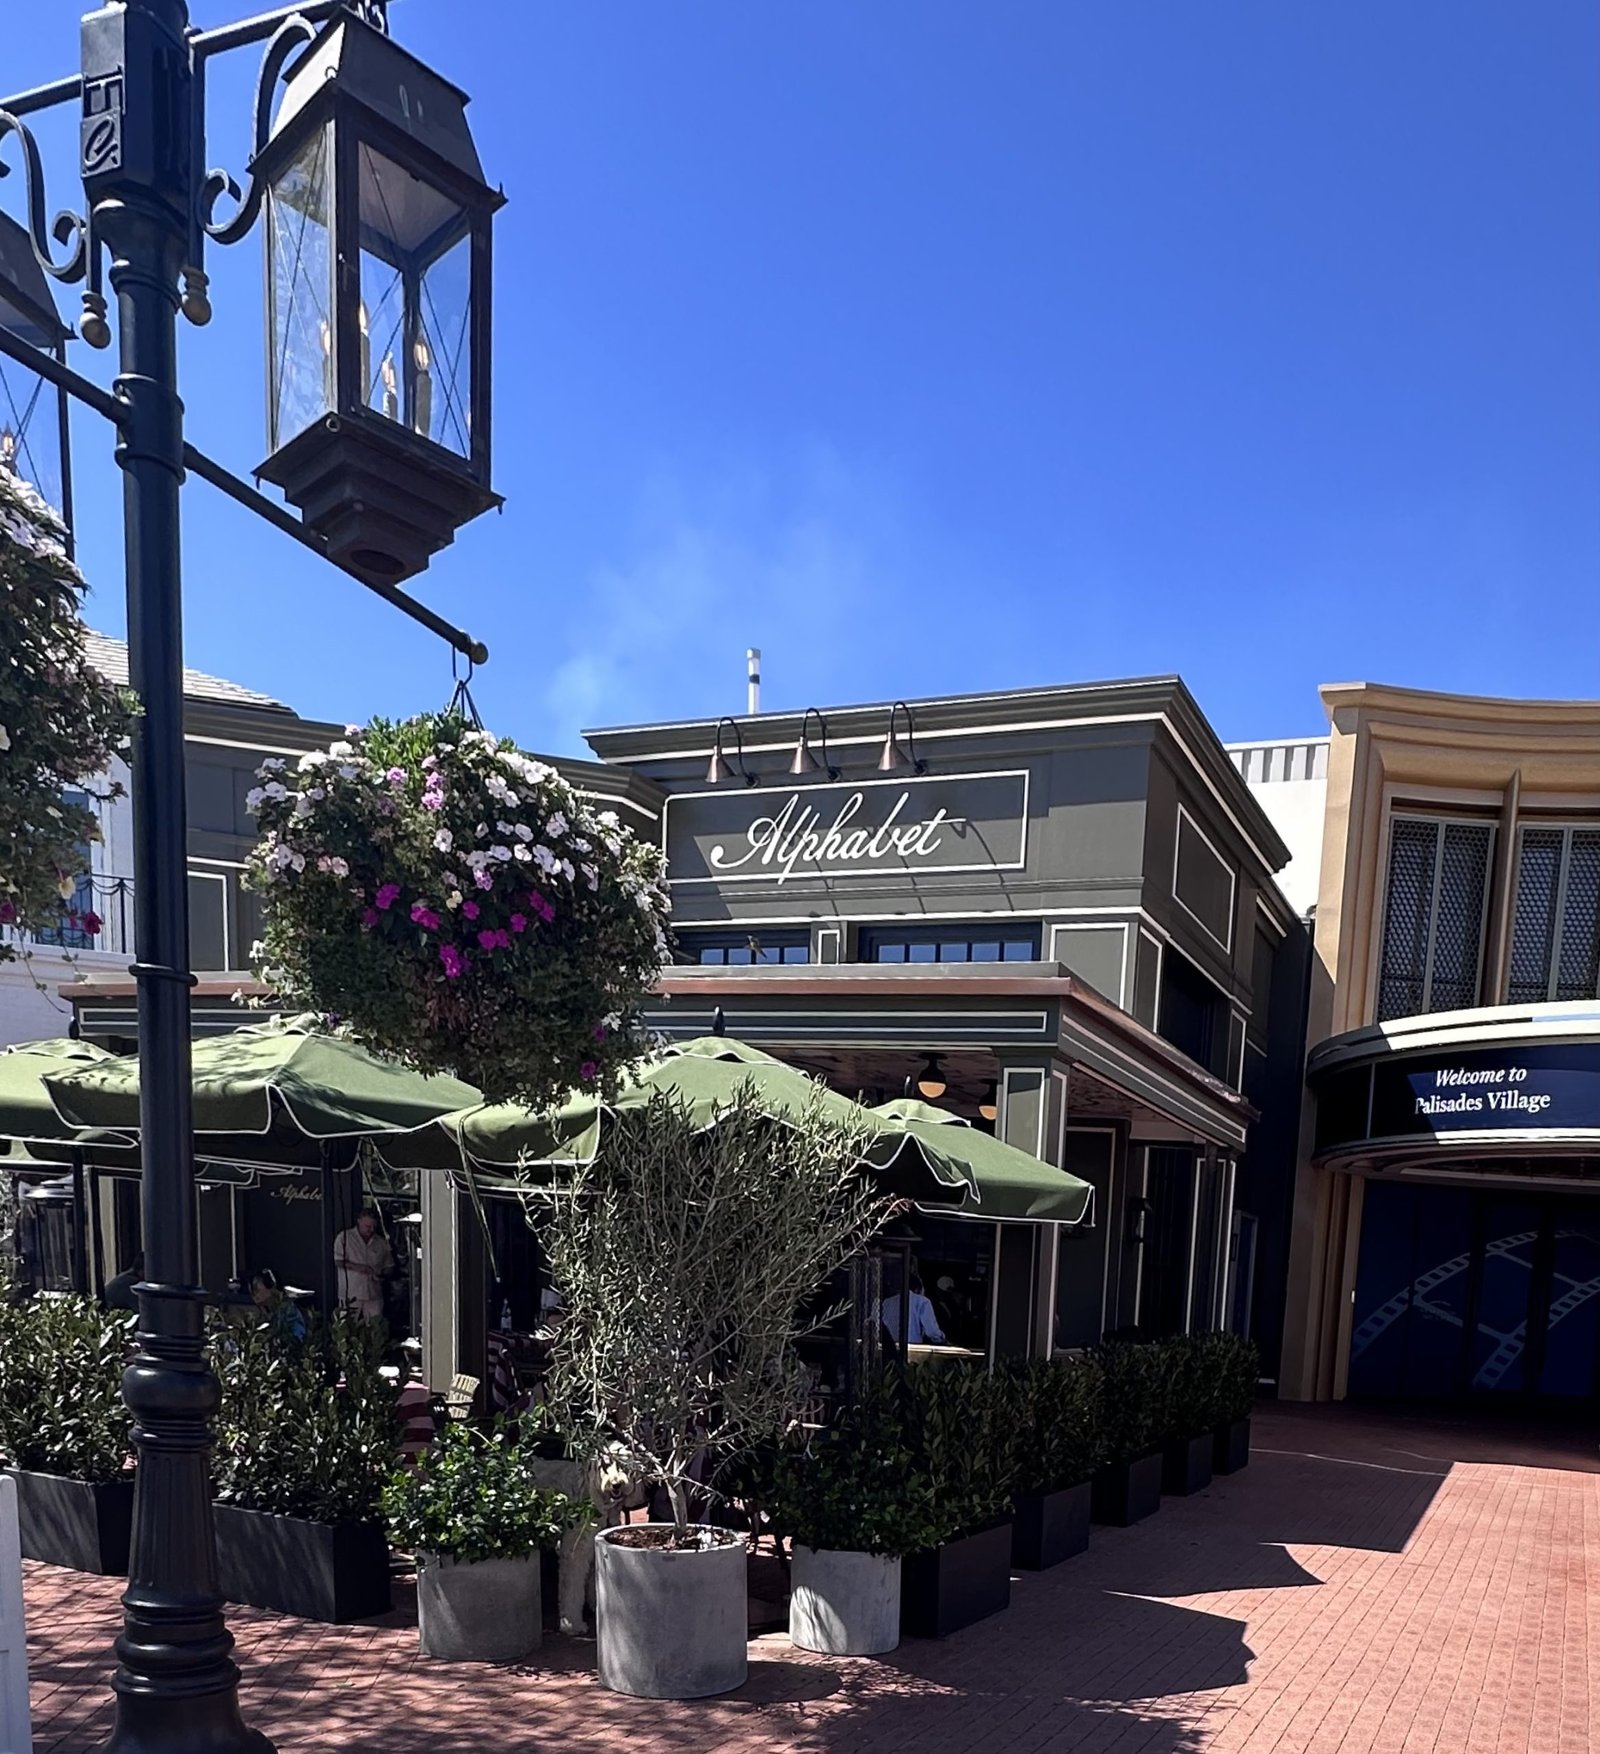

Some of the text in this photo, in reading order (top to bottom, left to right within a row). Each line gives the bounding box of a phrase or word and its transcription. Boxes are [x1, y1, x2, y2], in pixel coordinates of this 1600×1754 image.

[710, 792, 967, 885] Alphabet
[1436, 1066, 1527, 1087] Welcome to
[1415, 1089, 1551, 1114] Palisades Village
